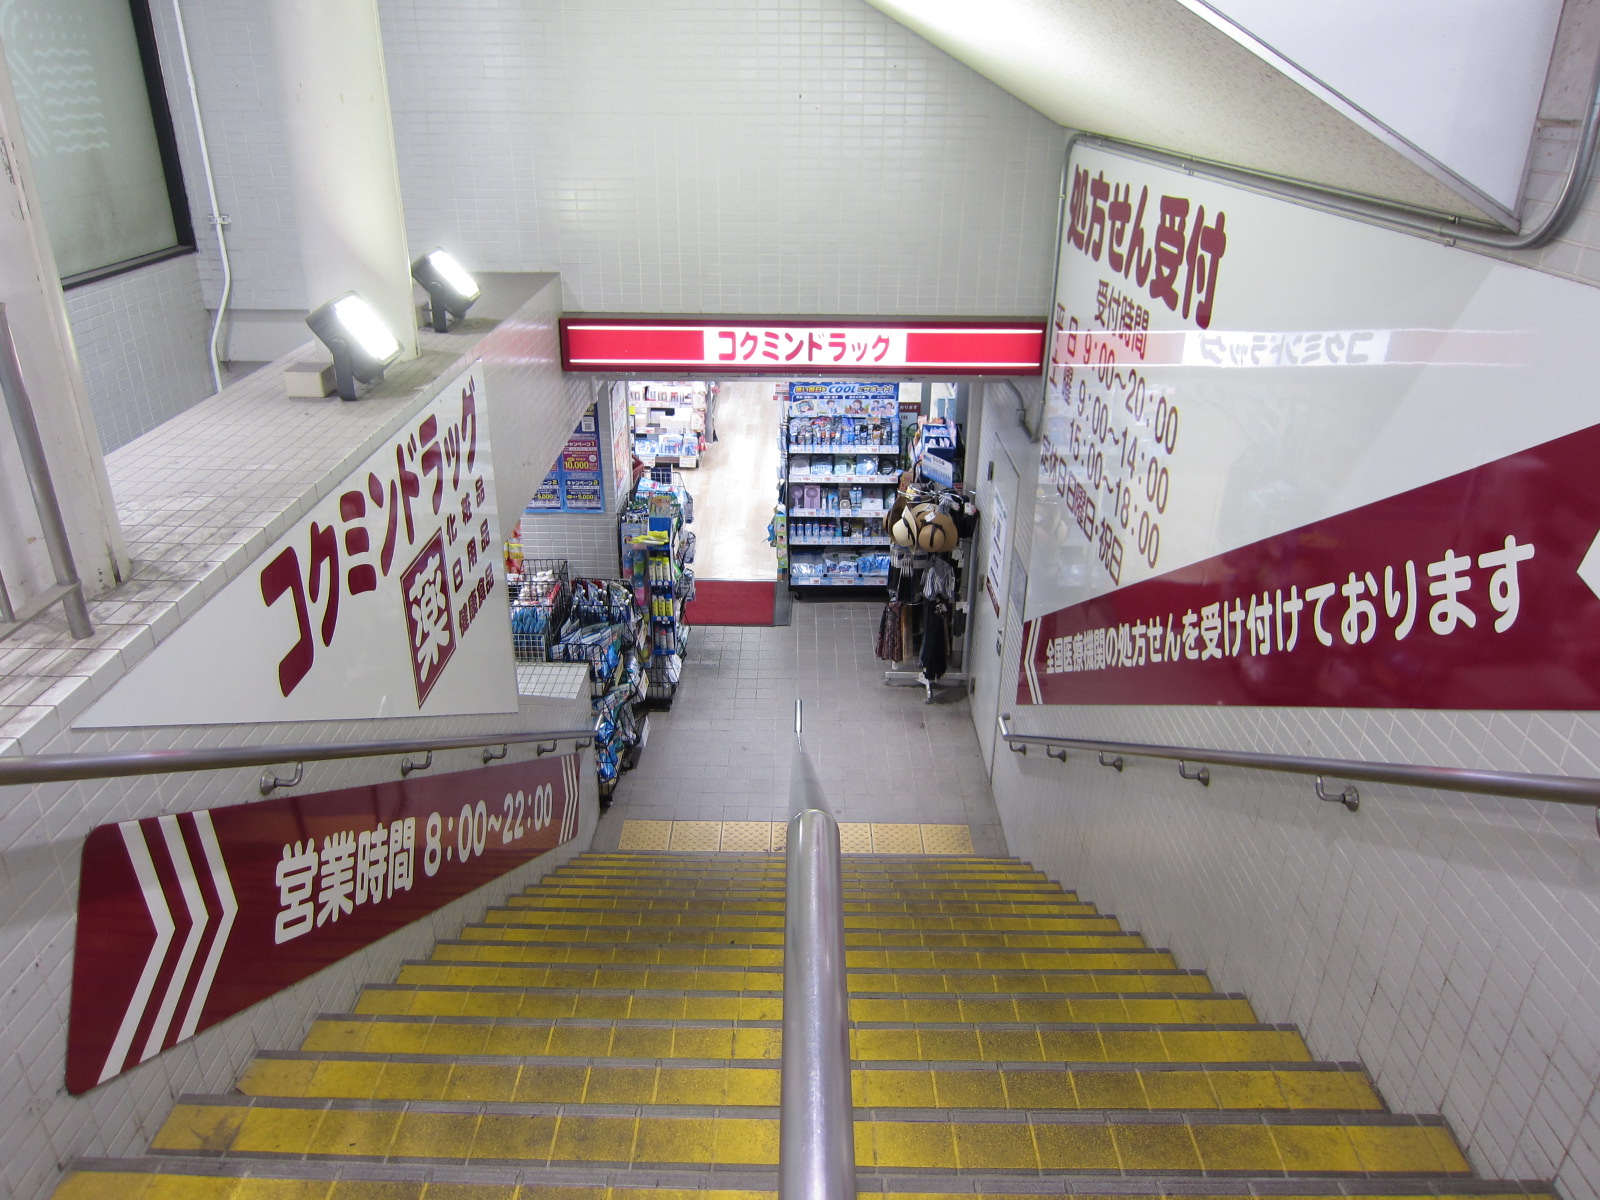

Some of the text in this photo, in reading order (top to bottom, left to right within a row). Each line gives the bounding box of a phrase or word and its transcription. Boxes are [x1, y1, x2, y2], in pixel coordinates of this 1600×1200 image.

[1067, 164, 1227, 330] 処方せん受付
[718, 330, 892, 363] コクミンドラッグ
[1094, 280, 1150, 361] 受付時間
[446, 475, 486, 547] 化粧品
[1068, 417, 1160, 569] 15:00~18:00
[1077, 379, 1169, 515] 9:00~14:00
[260, 375, 477, 698] コクミンドラッグ
[452, 518, 491, 594] 日用品
[458, 562, 495, 638] 健康食品
[410, 551, 452, 684] 薬
[1045, 534, 1535, 675] 全国医療機関の処方せんを受け付けております
[274, 782, 553, 945] 営業時間 8:00~22:00
